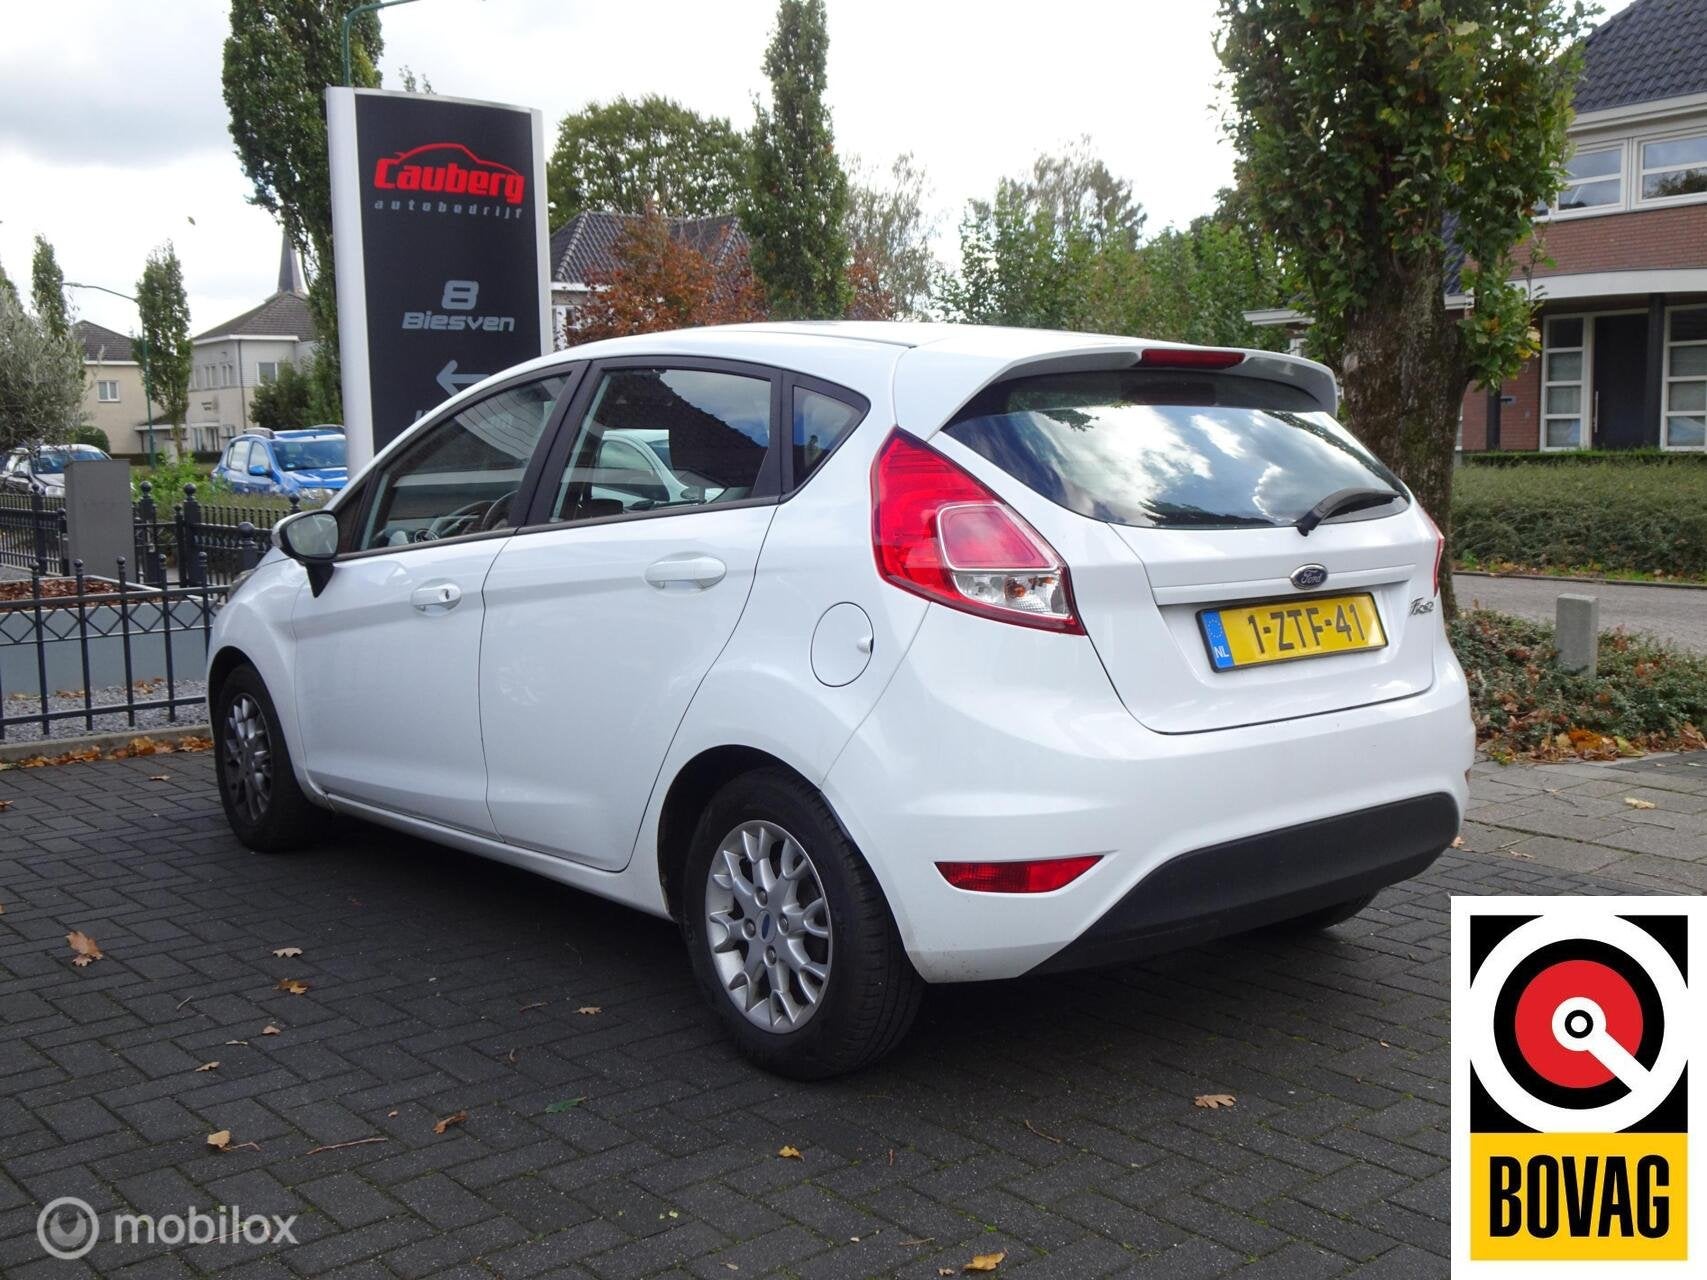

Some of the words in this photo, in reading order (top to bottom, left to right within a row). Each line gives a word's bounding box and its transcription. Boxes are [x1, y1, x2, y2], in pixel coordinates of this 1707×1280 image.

[374, 158, 525, 204] Cauberg
[374, 199, 523, 219] autobedrijf
[441, 279, 480, 310] 8
[401, 310, 515, 332] Biesven
[1301, 570, 1321, 584] Ford
[1247, 603, 1365, 654] 1-ZTF-41
[1213, 645, 1230, 658] NL
